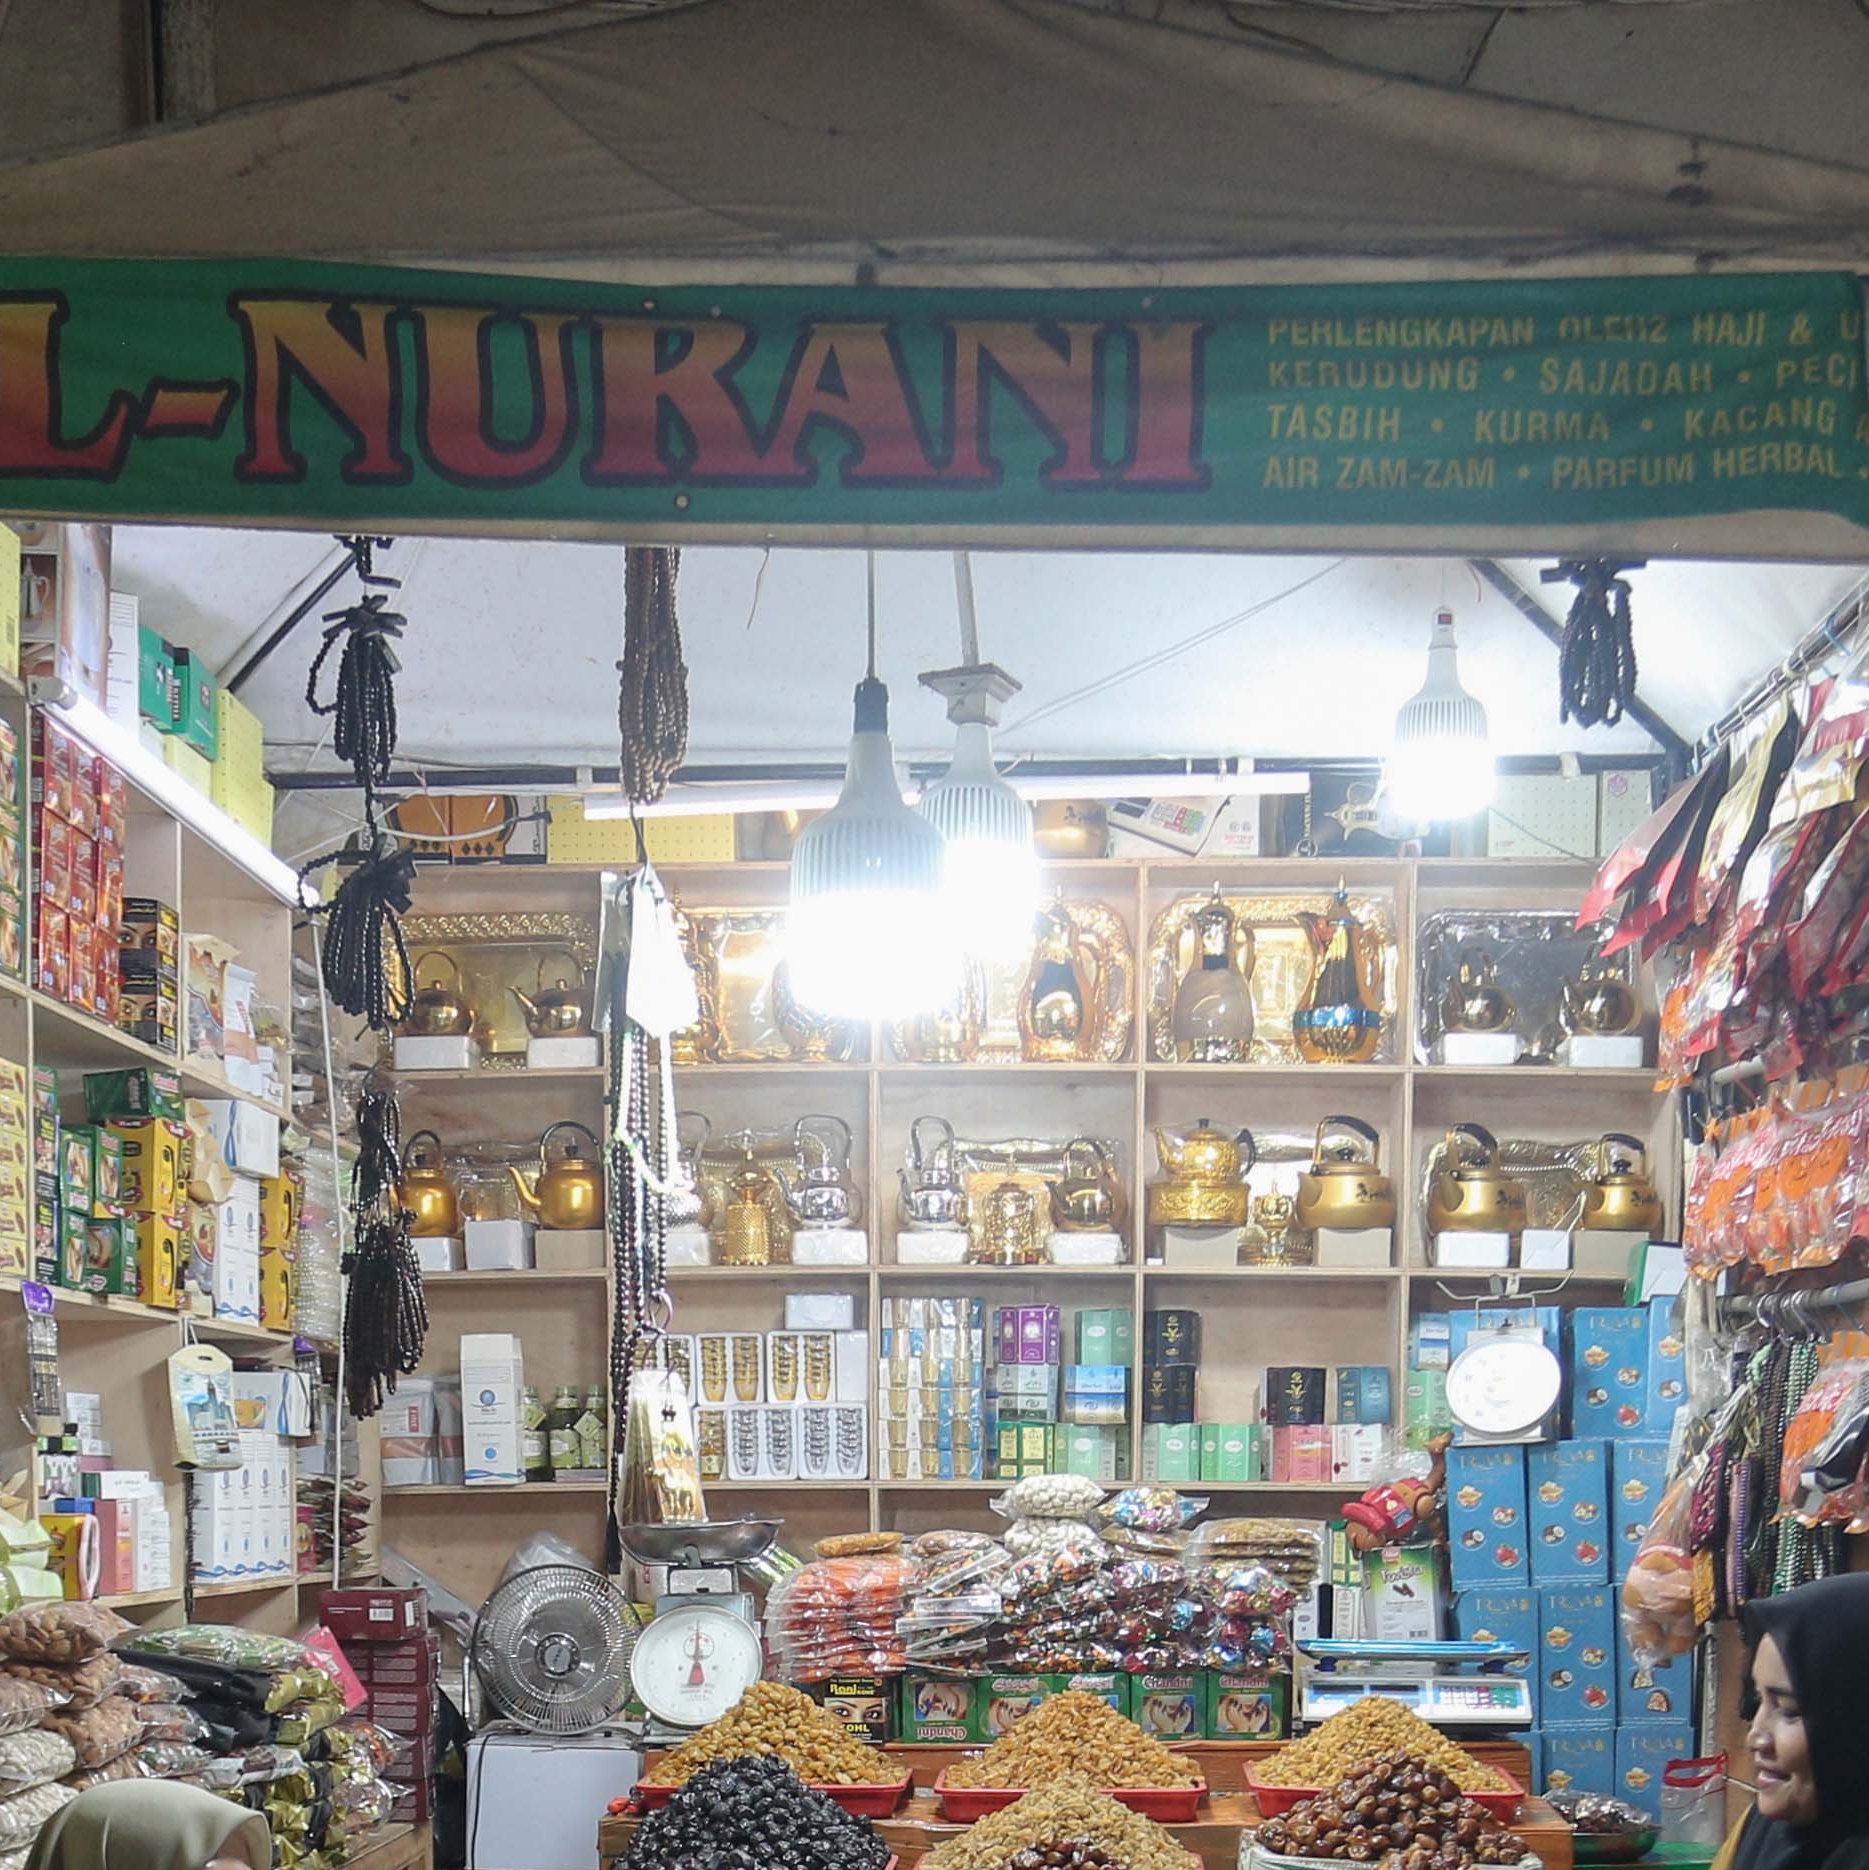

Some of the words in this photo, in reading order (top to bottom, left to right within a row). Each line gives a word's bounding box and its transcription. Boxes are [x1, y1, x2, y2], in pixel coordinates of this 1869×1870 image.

[1268, 317, 1536, 348] PERLENGKAPAN
[1692, 311, 1767, 346] HAJI
[1789, 313, 1812, 345] &
[1268, 356, 1478, 392] KERUDUNG
[1539, 356, 1713, 397] SAJADAH
[1776, 352, 1859, 392] PECI
[1266, 404, 1403, 442] TASBIH
[1474, 408, 1611, 445] KURMA
[1684, 394, 1839, 442] KACANG
[1262, 456, 1320, 490] AIR
[1335, 457, 1497, 490] ZAM-ZAM
[1552, 452, 1697, 489] PARFUM
[1712, 440, 1844, 481] HERBAL
[1142, 1677, 1196, 1691] Chandni
